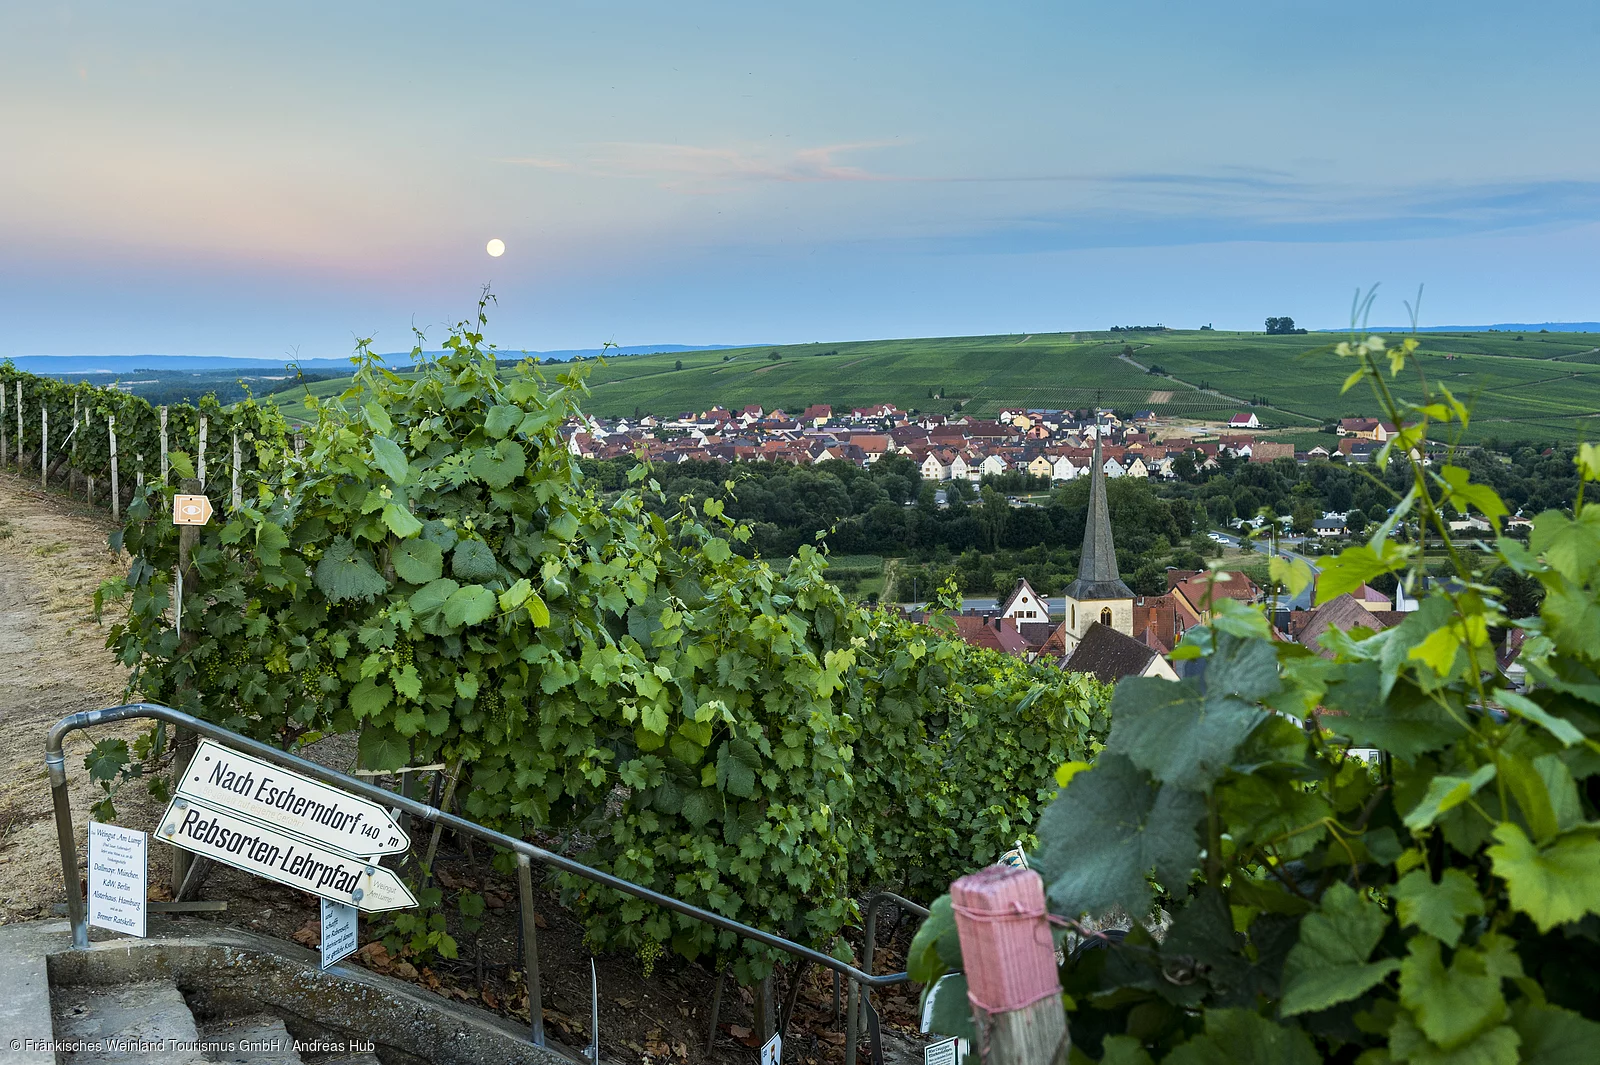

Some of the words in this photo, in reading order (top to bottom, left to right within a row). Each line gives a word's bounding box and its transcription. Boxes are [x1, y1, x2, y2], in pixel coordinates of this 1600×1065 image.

[208, 760, 254, 797] Nach
[254, 777, 364, 834] Escherndorf
[360, 823, 381, 840] 140
[387, 836, 399, 848] m
[178, 808, 364, 895] Rebsorten-Lehrpfad
